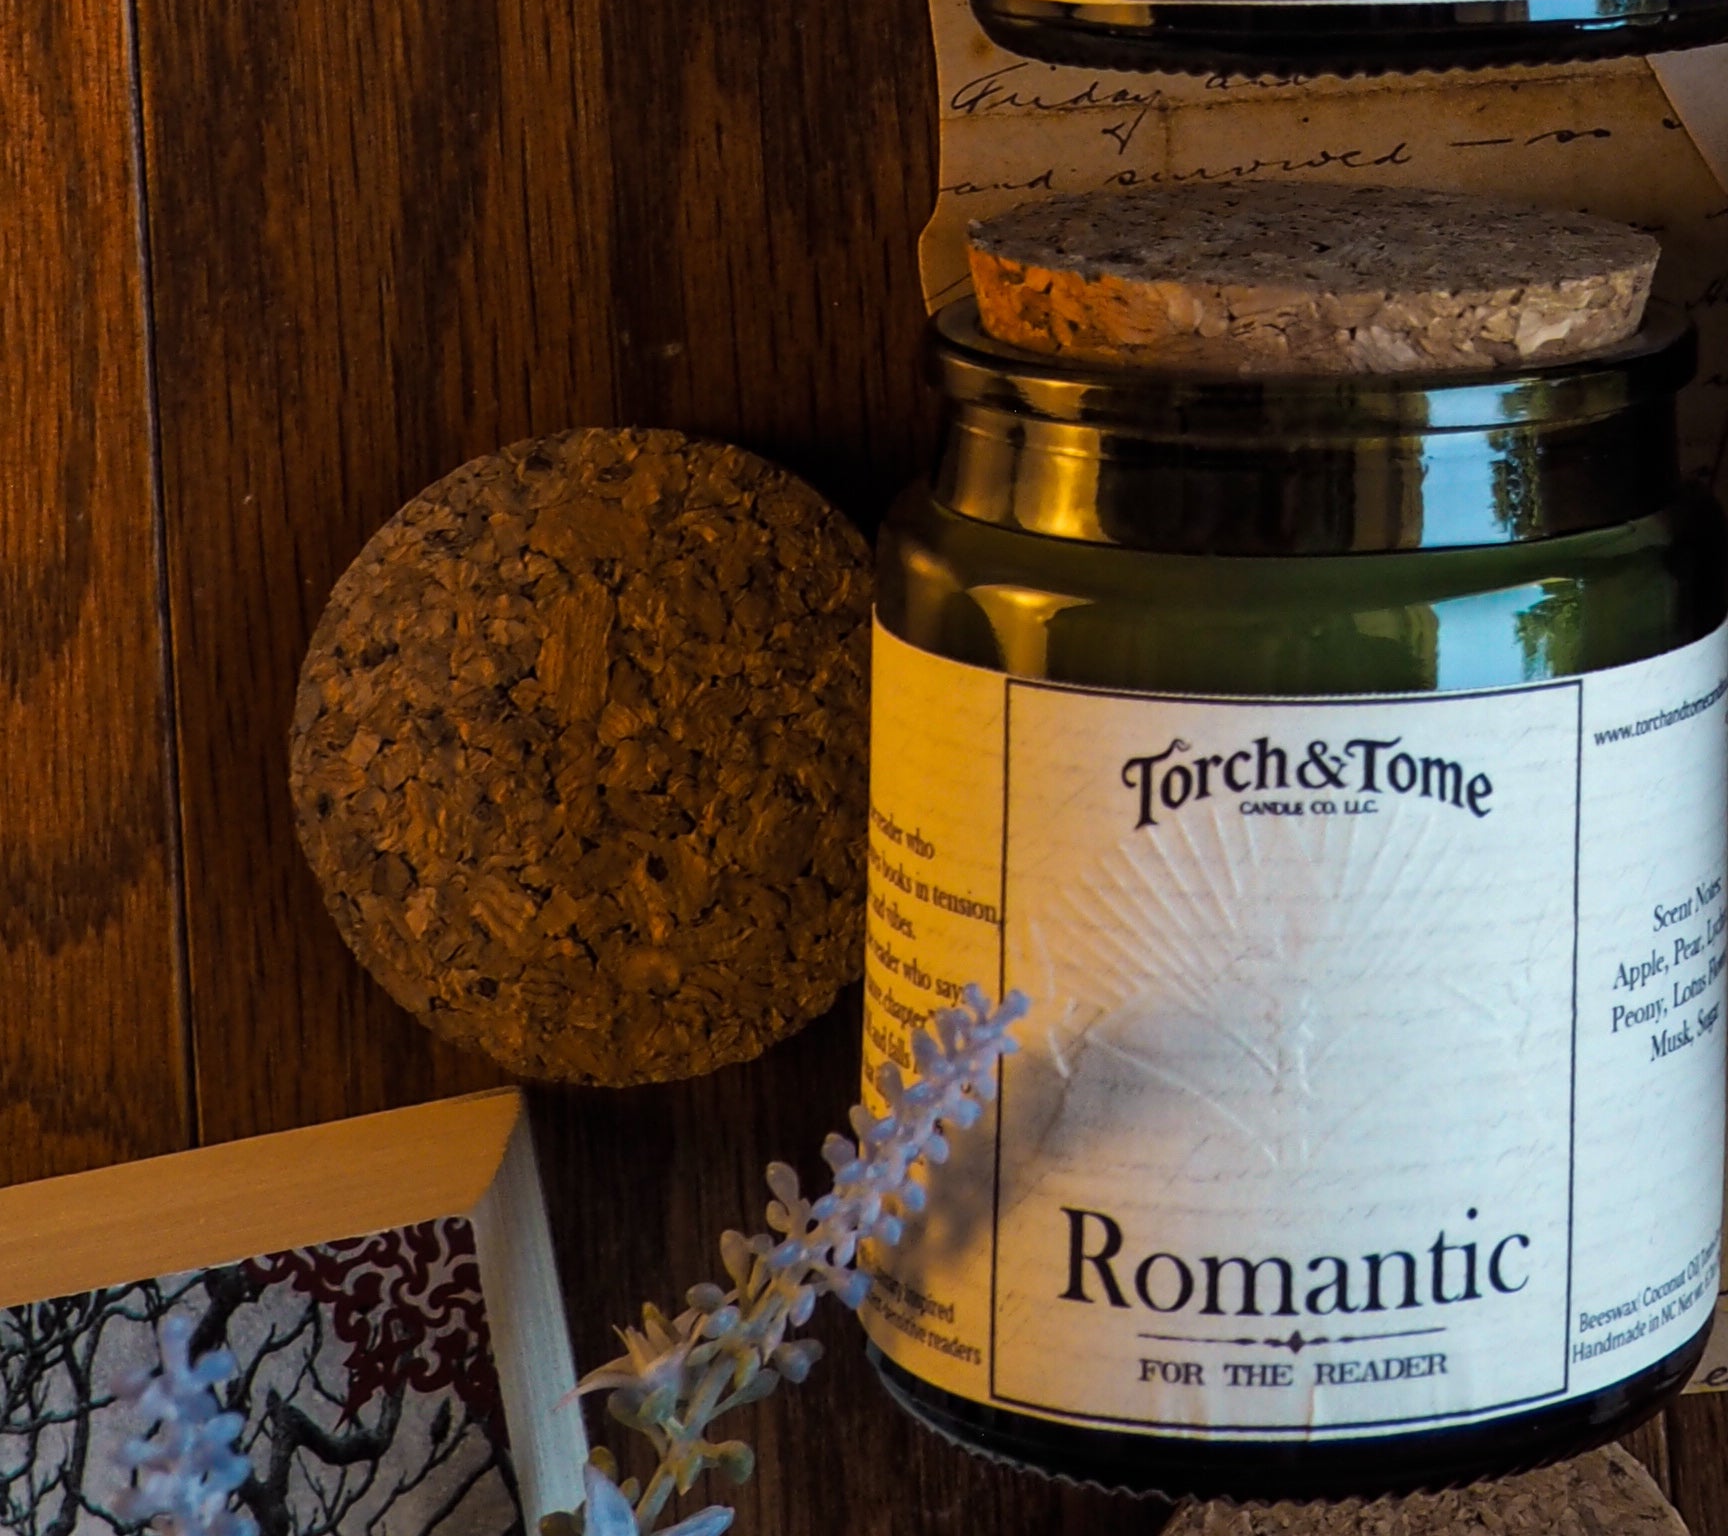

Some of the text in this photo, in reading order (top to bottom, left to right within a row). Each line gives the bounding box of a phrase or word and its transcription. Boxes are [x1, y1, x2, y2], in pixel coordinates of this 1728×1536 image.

[1240, 800, 1337, 816] CANDLE CO.
[906, 827, 936, 861] who
[915, 871, 930, 903] in
[1652, 897, 1693, 933] Scent
[903, 958, 931, 991] who
[1612, 948, 1670, 992] Apple,
[1611, 974, 1707, 1034] Peony, Lotus
[1058, 1207, 1530, 1317] Romantic
[927, 1330, 982, 1366] readers
[1572, 1299, 1676, 1364] Handmade in NC
[1137, 1352, 1448, 1386] FOR THE READER
